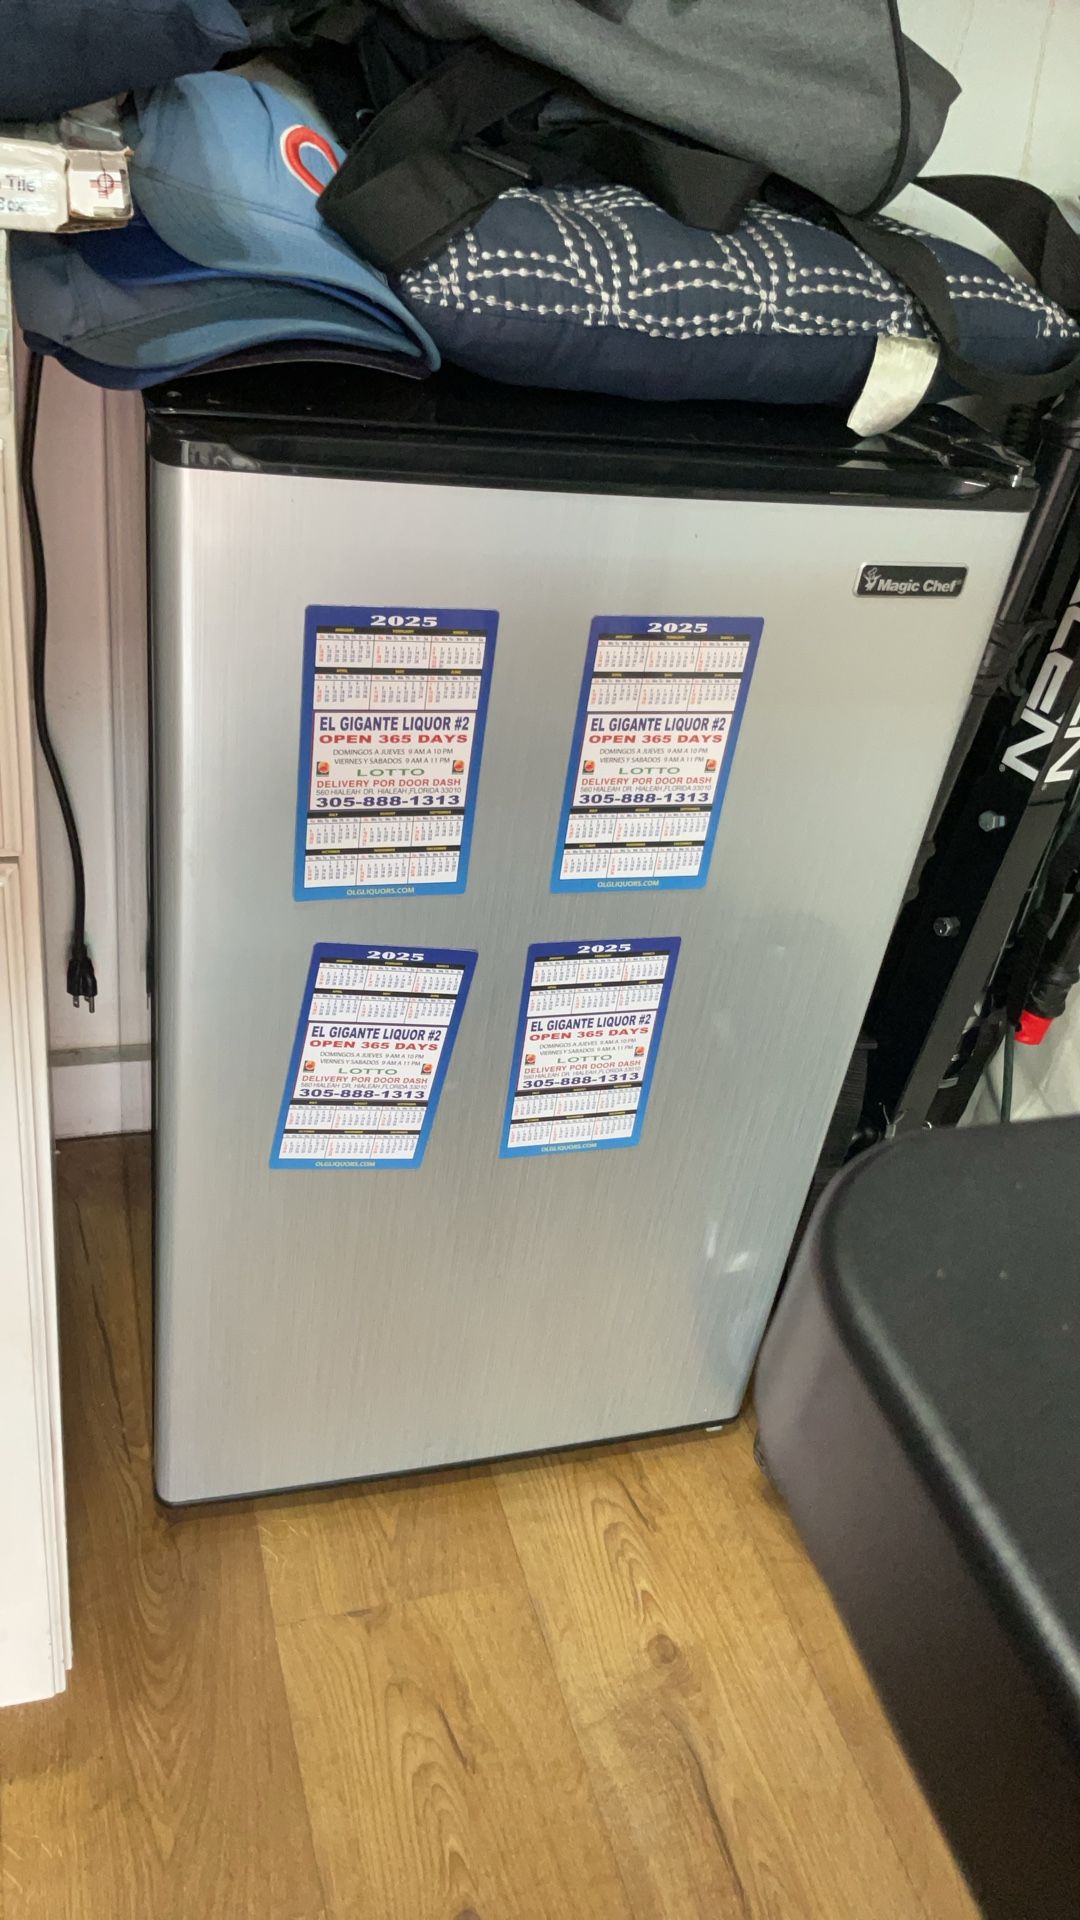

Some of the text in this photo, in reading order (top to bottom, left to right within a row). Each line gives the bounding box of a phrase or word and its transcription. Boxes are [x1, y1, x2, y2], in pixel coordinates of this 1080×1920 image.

[877, 578, 957, 595] Magic Chef
[370, 615, 438, 627] 2025
[647, 622, 708, 633] 2025
[320, 717, 470, 731] EL GIGANTE LIQUOR #2
[591, 718, 727, 732] EL GIGANTE LIQUOR #2
[319, 735, 468, 744] OPEN 365 DAYS
[589, 735, 723, 743] OPEN 365 DAYS
[317, 780, 369, 788] DELIVERY
[399, 779, 429, 787] DOOR
[316, 796, 460, 807] 305-888-1313
[579, 793, 710, 804] 305-888-1313
[596, 880, 659, 888] OLGLIQUORS.COM
[346, 887, 415, 896] OLGLIQUORS.COM
[577, 943, 632, 954] 2025
[367, 950, 425, 961] 2025
[531, 1014, 652, 1032] EL GIGANTE LIQUOR #2
[311, 1026, 442, 1041] EL GIGANTE LIQUOR #2
[529, 1027, 649, 1041] OPEN 365 DAYS
[309, 1040, 355, 1048] OPEN
[395, 1043, 438, 1051] DAYS
[557, 1054, 612, 1064] LOTTO
[524, 1066, 567, 1074] DELIVERY
[522, 1073, 639, 1088] 305-888-1313
[299, 1089, 425, 1099] 305-888-1313
